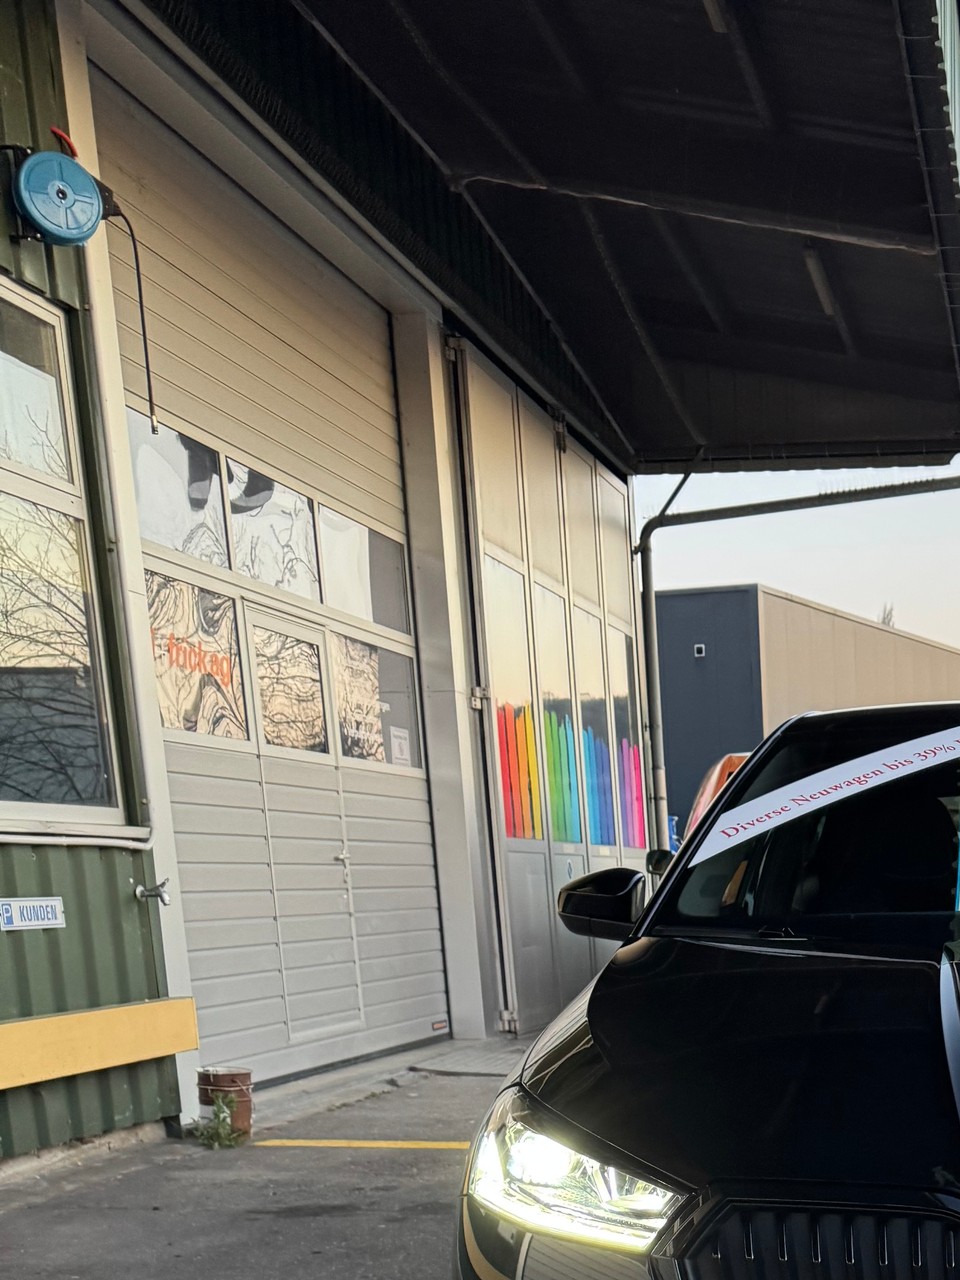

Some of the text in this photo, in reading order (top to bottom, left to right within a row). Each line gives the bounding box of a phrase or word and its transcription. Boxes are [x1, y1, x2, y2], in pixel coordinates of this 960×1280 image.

[719, 805, 792, 839] Diverse
[790, 769, 885, 806] Neuwagen
[882, 757, 914, 771] bis
[913, 744, 956, 762] 39%
[19, 904, 58, 922] KUNDEN
